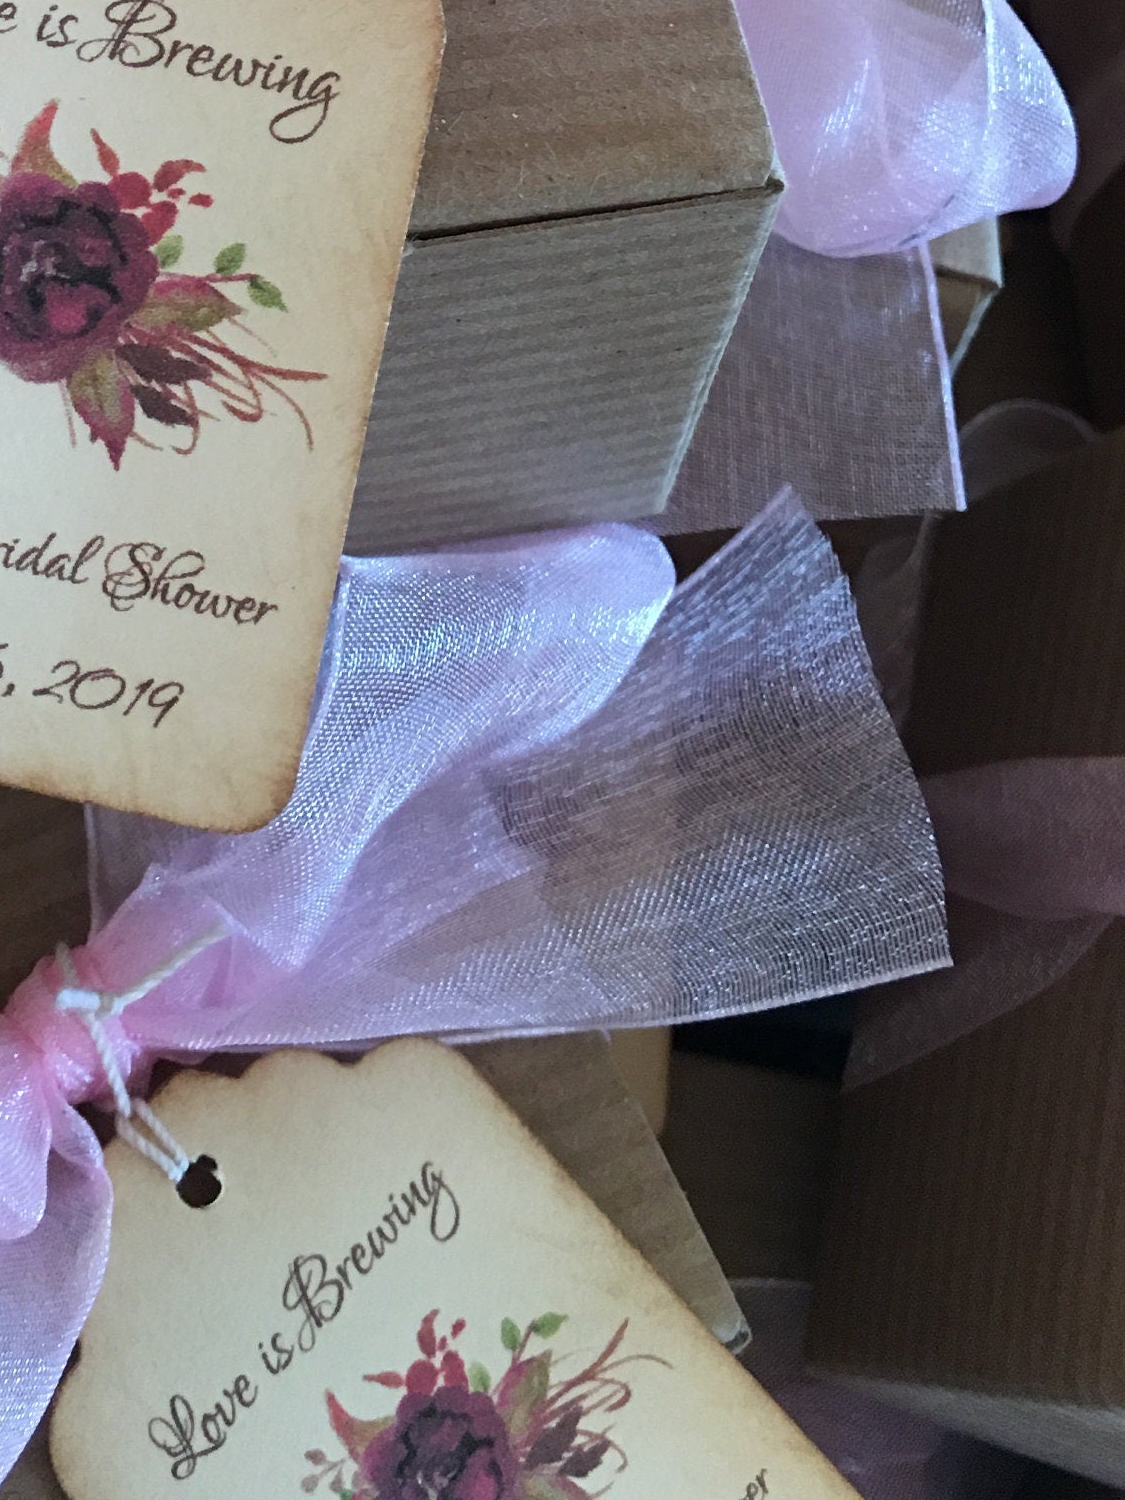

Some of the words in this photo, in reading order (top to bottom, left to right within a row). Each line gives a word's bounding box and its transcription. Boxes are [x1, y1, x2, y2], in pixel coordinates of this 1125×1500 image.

[36, 4, 78, 48] is
[101, 542, 279, 626] Shower
[31, 659, 184, 728] 2019
[148, 1373, 259, 1480] Love
[257, 1332, 294, 1375] is
[281, 1160, 461, 1353] Brewing
